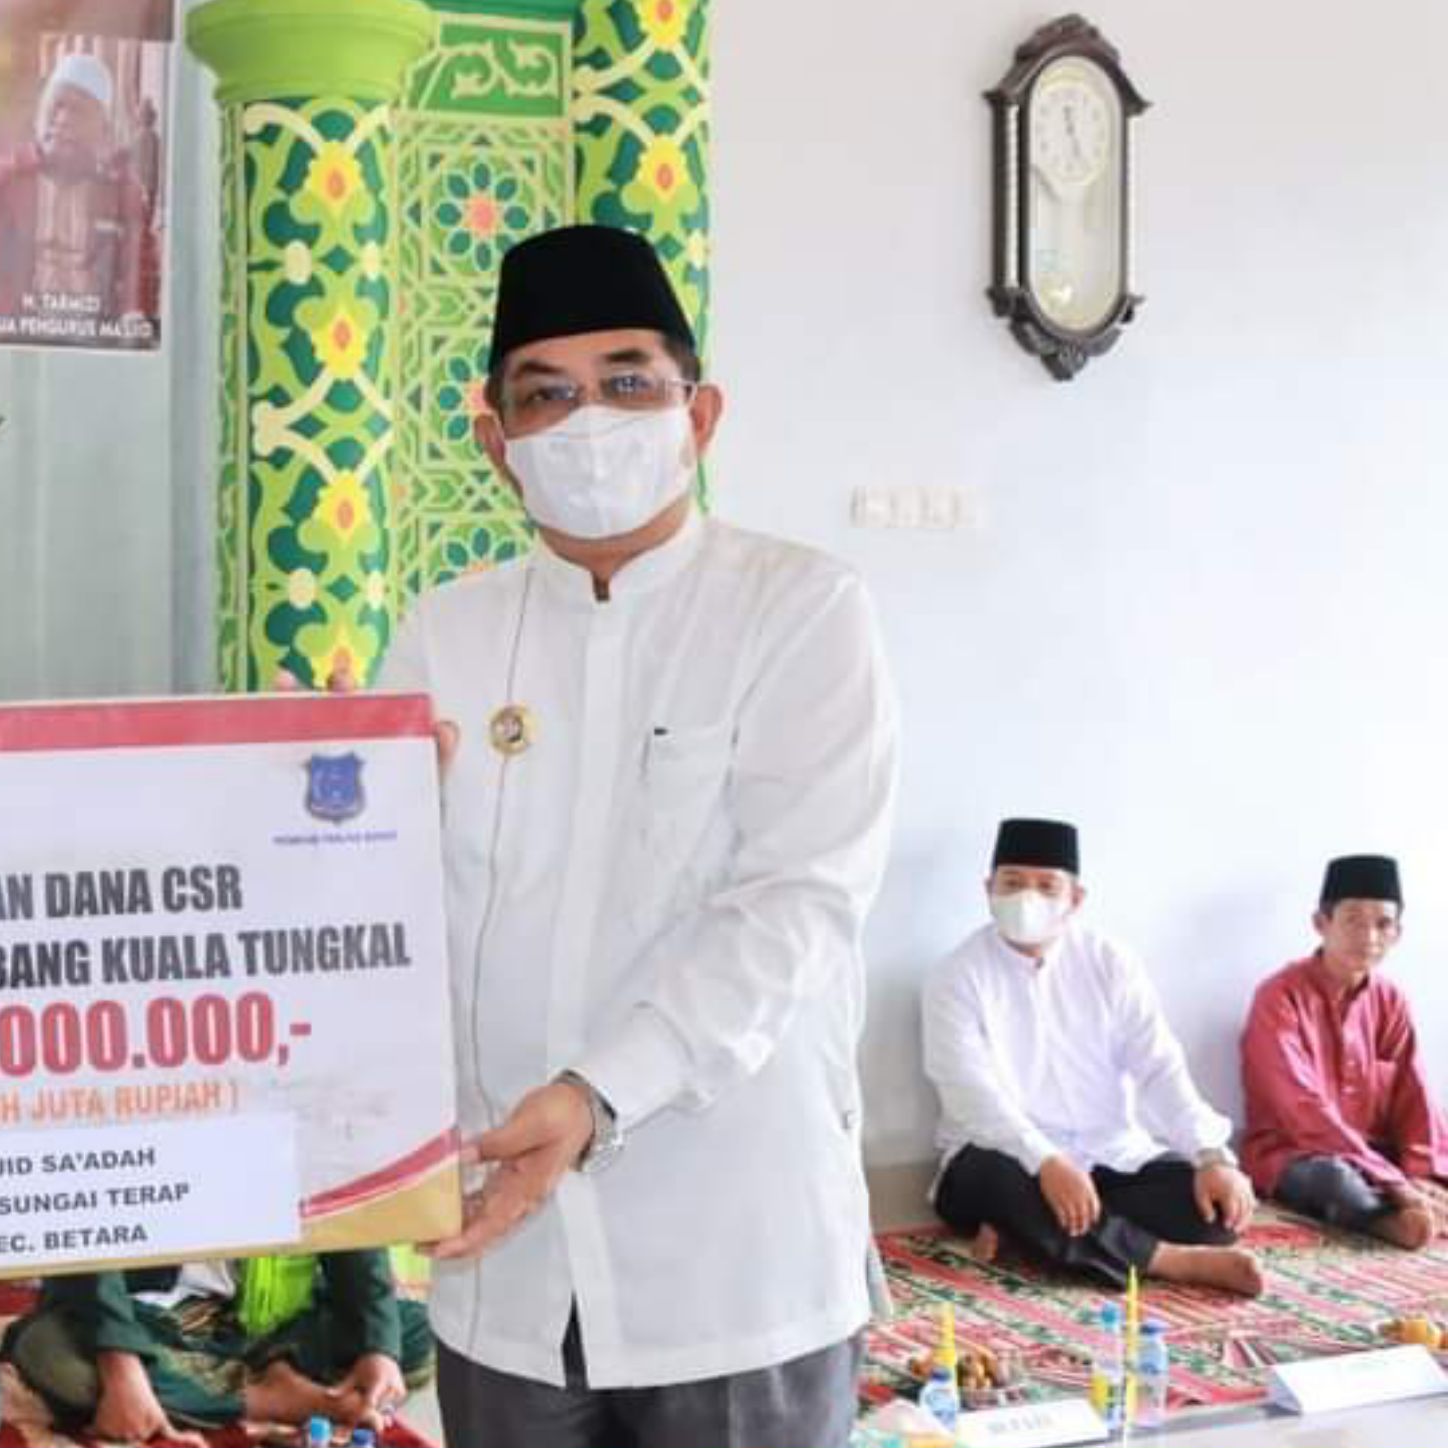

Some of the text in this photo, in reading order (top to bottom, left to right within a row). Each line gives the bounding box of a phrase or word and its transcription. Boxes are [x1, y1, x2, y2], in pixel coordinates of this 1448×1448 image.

[44, 868, 154, 918] DANA
[161, 864, 244, 913] CSR
[101, 932, 231, 985] KUALA
[237, 922, 413, 976] TUNGKAL
[30, 1086, 104, 1121] JUTA
[113, 1081, 222, 1118] RUPIAH
[41, 1147, 156, 1173] SA'ADAH
[106, 1182, 190, 1207] TERAP
[44, 1224, 149, 1250] BETARA
